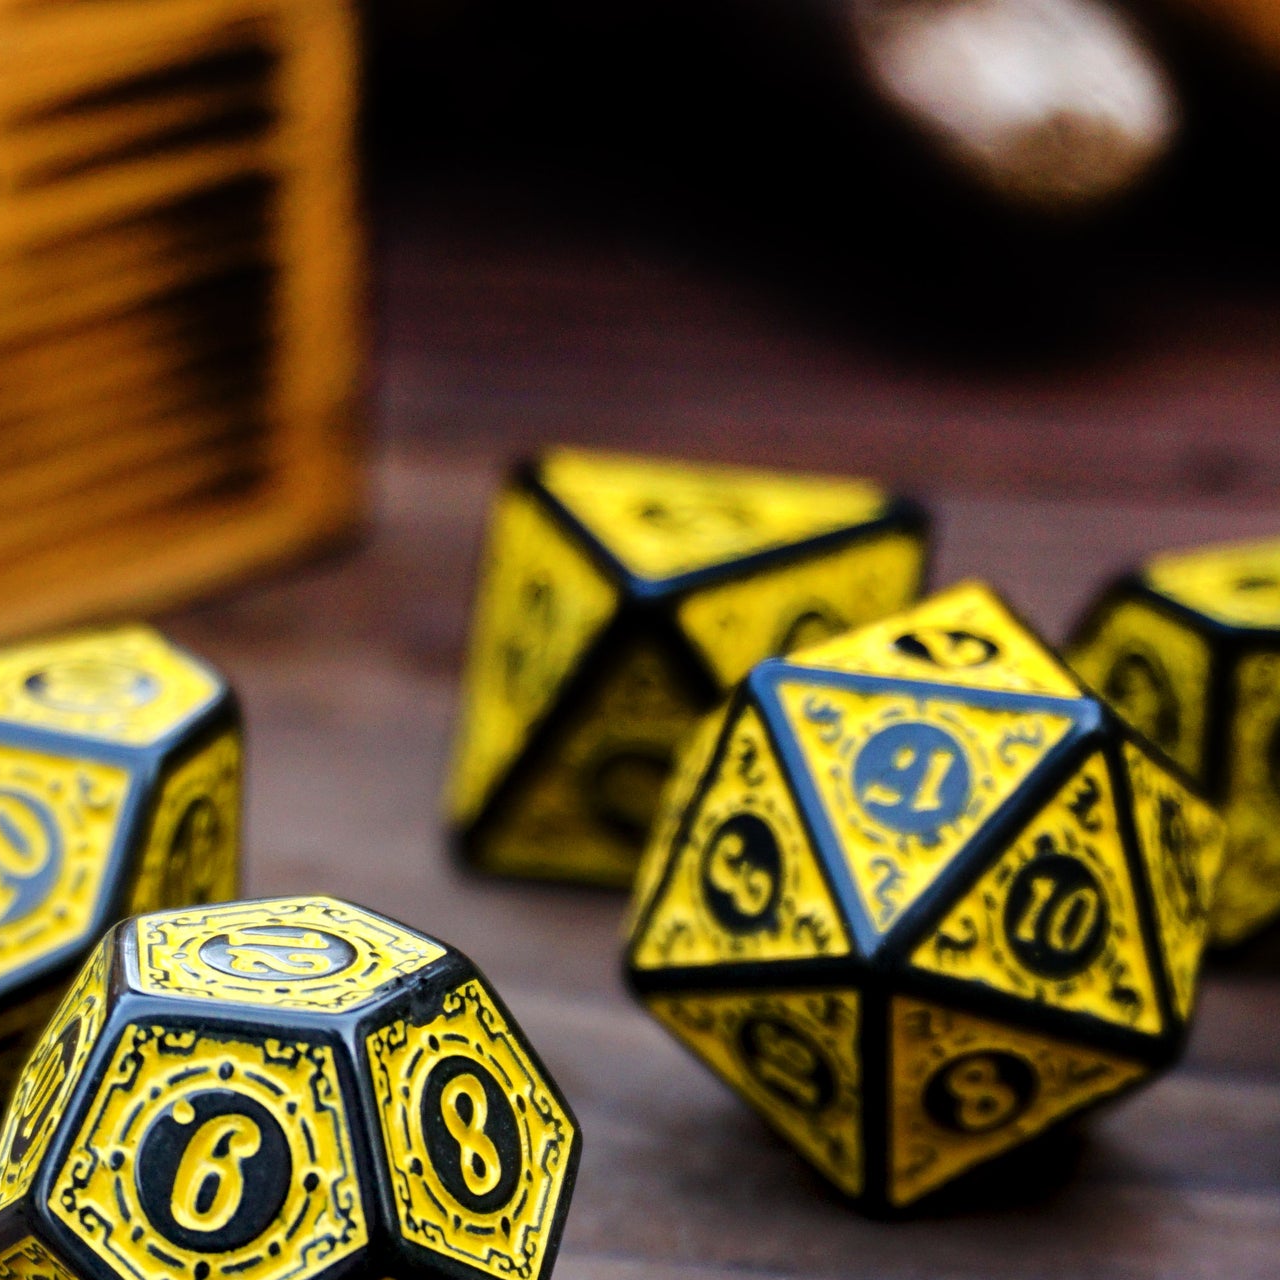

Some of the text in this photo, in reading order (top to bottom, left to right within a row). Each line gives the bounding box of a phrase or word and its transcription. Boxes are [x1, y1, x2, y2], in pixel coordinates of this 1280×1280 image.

[1014, 875, 1099, 953] 10
[226, 931, 334, 976] 12
[948, 1057, 1018, 1133] 8
[440, 1072, 503, 1196] 8
